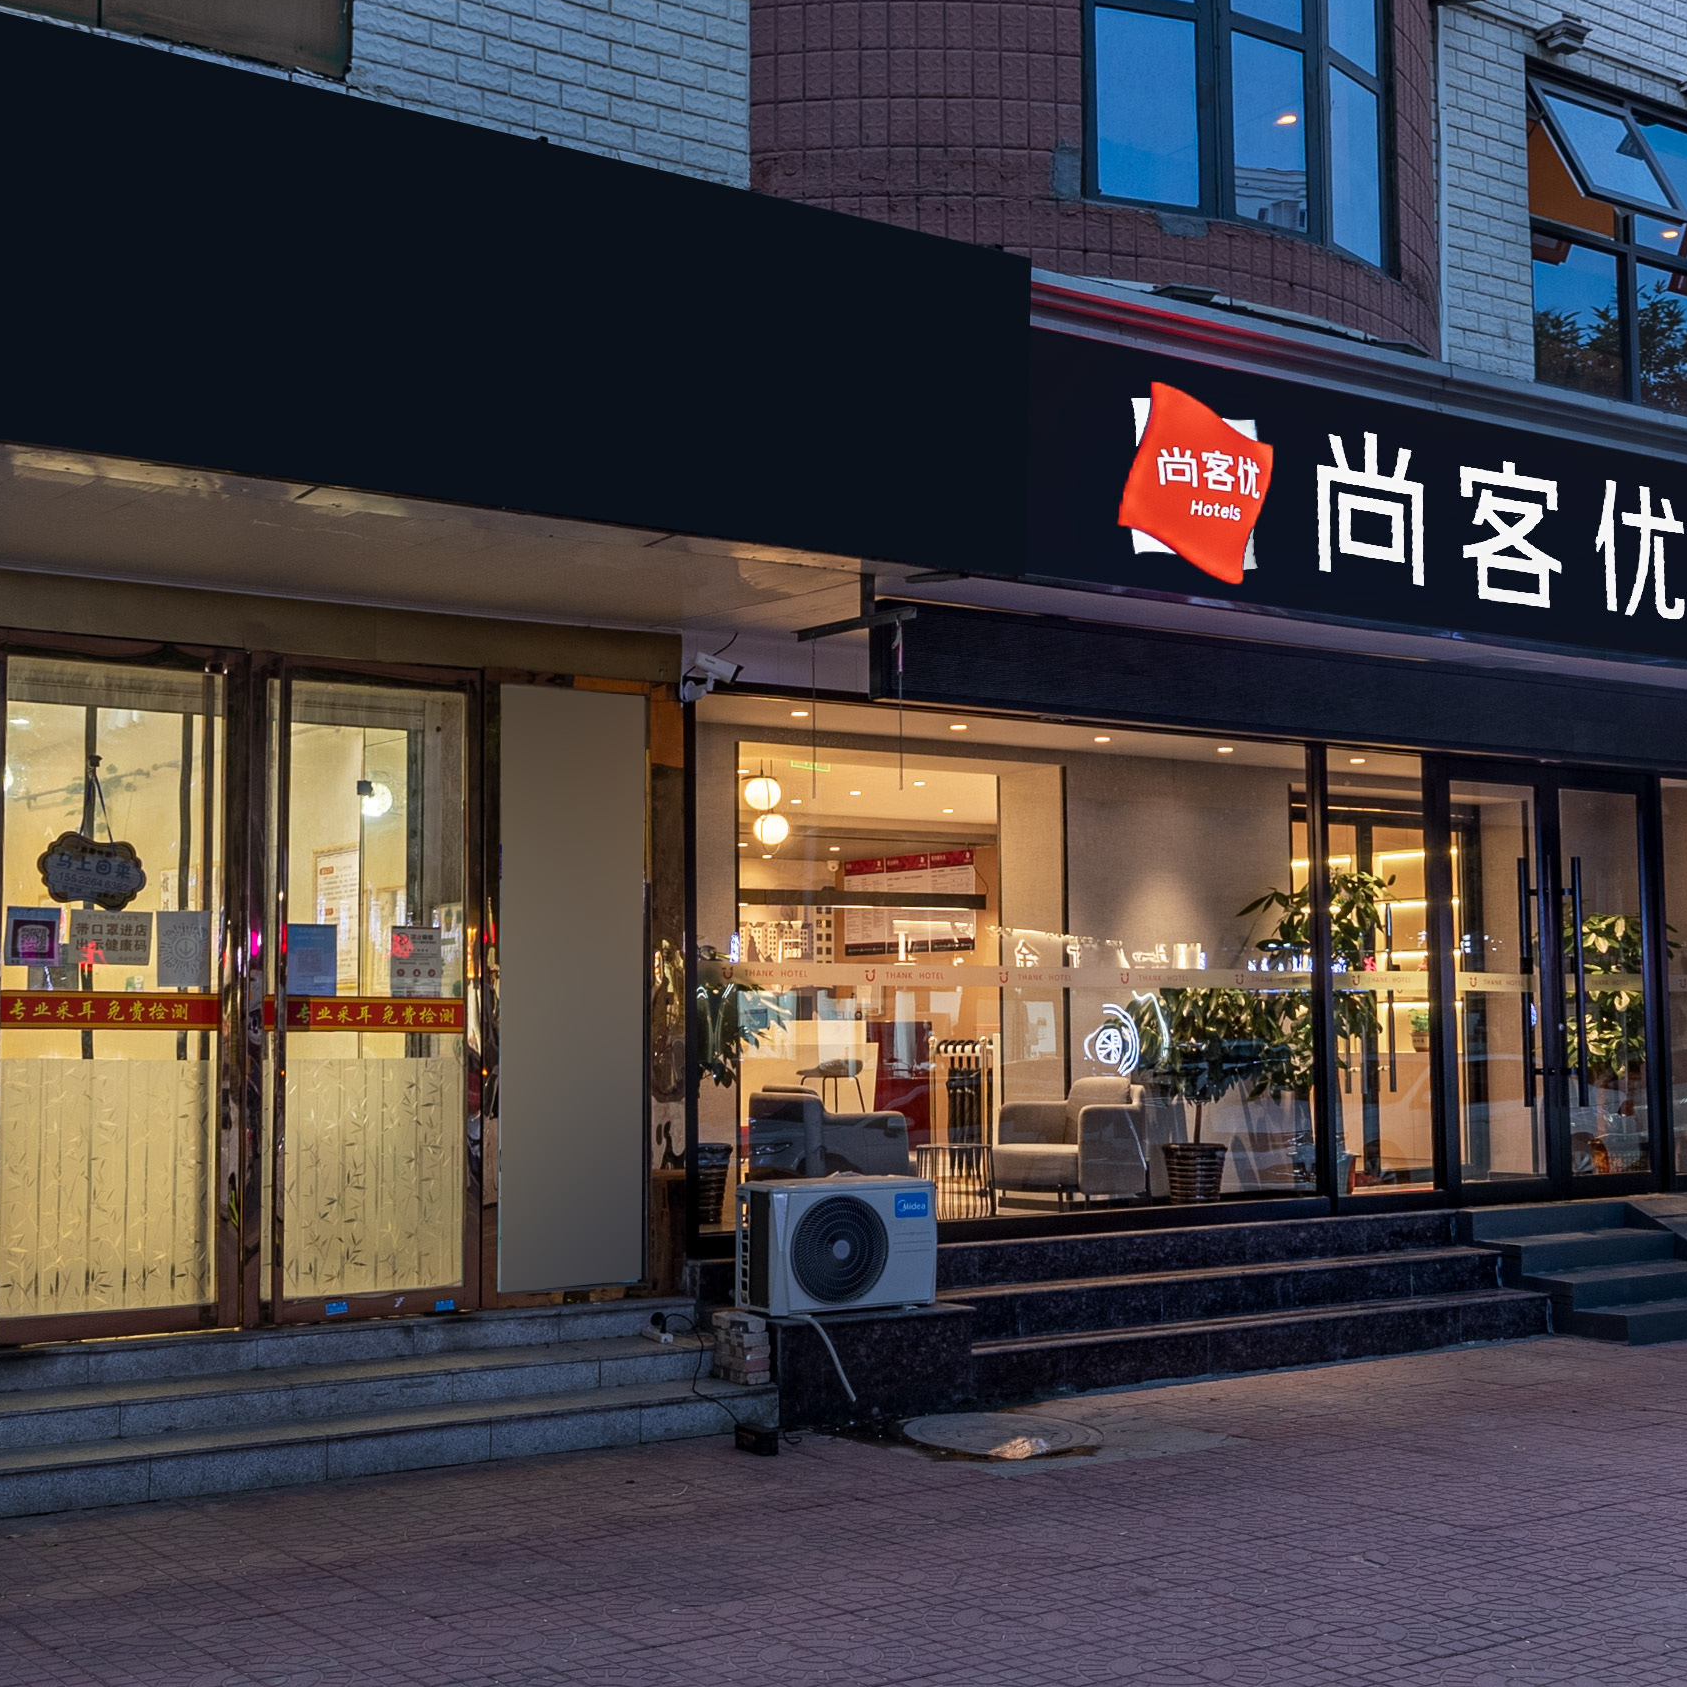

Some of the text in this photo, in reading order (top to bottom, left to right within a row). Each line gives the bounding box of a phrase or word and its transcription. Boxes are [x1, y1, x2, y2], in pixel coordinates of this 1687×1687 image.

[1156, 446, 1261, 499] 尚客优
[1189, 499, 1241, 521] Hotels
[75, 922, 148, 936] 带口罩进店
[75, 938, 147, 952] 出示健康码
[744, 969, 809, 978] THANK HOTEL
[885, 972, 945, 980] THANK HOTEL
[1018, 973, 1073, 982] THANK HOTEL
[1138, 974, 1190, 983] THANK HOTEL
[9, 998, 189, 1021] 专业采耳 免费检测
[296, 1003, 455, 1025] 专业采耳 免费检测
[902, 1202, 926, 1211] Midea
